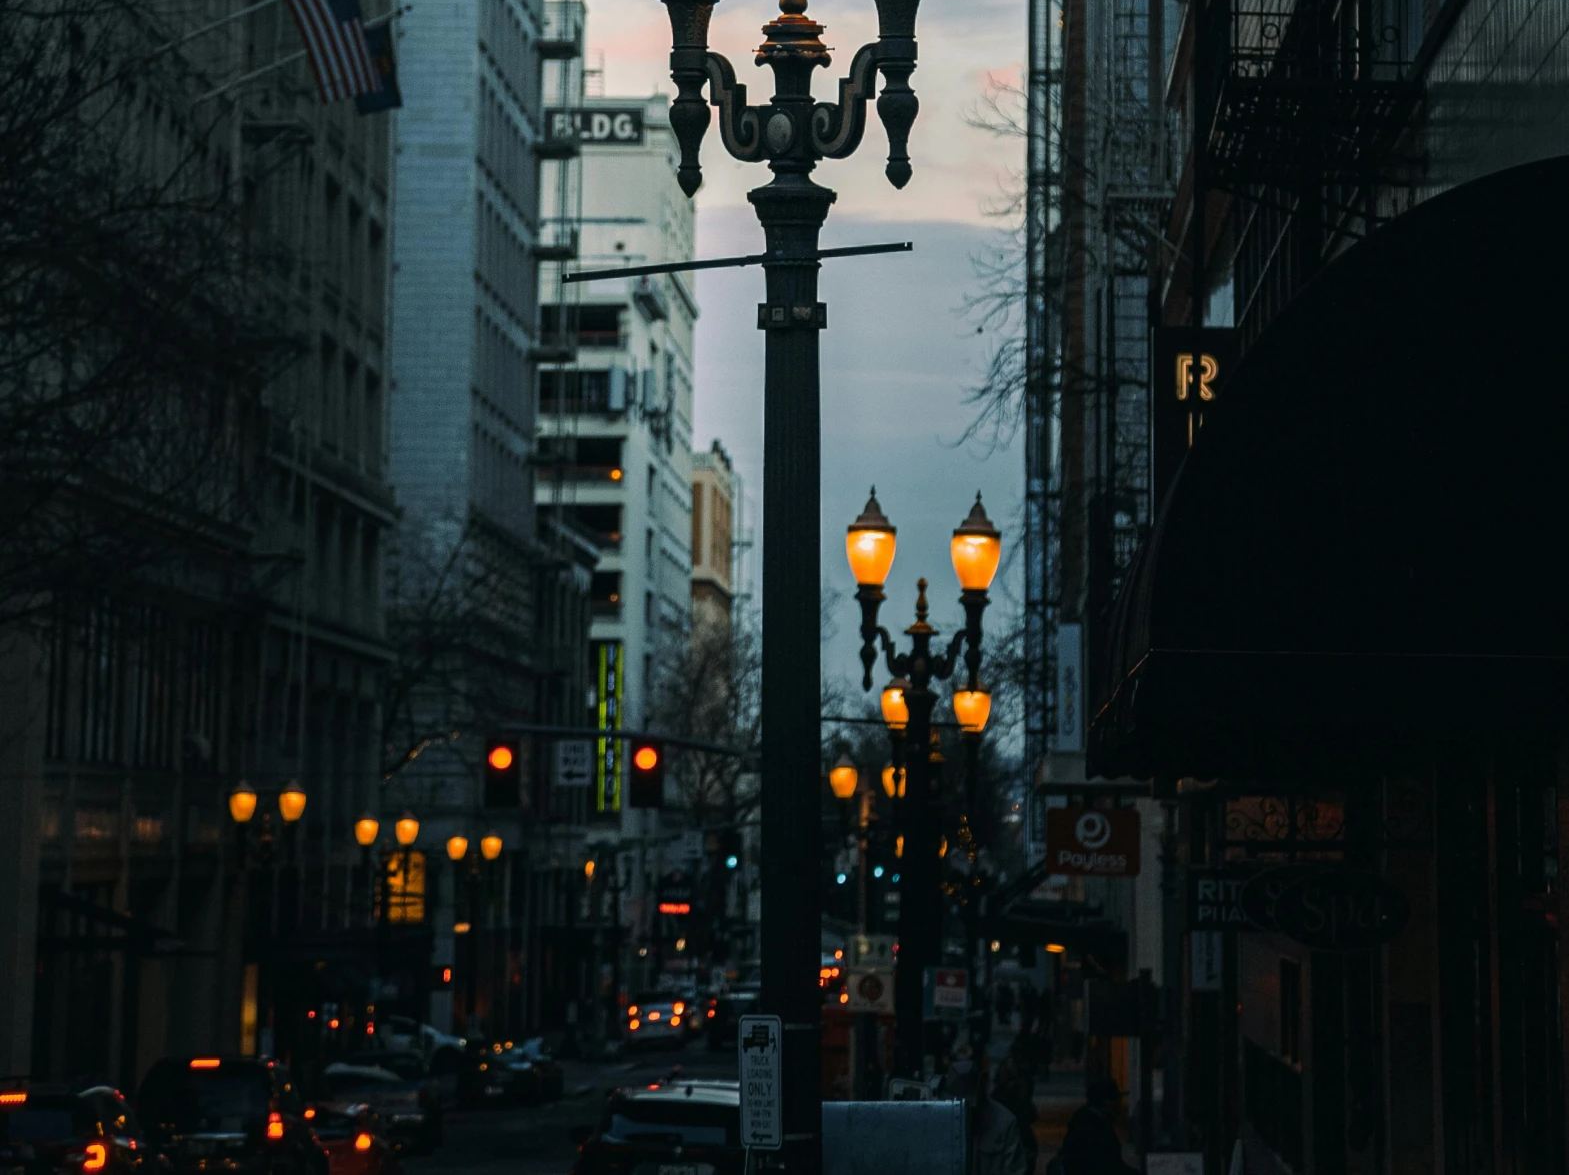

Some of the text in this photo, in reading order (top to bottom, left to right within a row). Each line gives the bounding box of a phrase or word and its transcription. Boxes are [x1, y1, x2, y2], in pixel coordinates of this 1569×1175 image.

[552, 113, 638, 139] BLDG.
[1058, 850, 1127, 870] Payless
[1198, 879, 1248, 902] RIT
[1198, 905, 1248, 922] PHA
[1302, 887, 1381, 944] Spa
[750, 1055, 770, 1066] TRUCK
[747, 1068, 773, 1079] LOADING
[748, 1081, 772, 1096] ONLY
